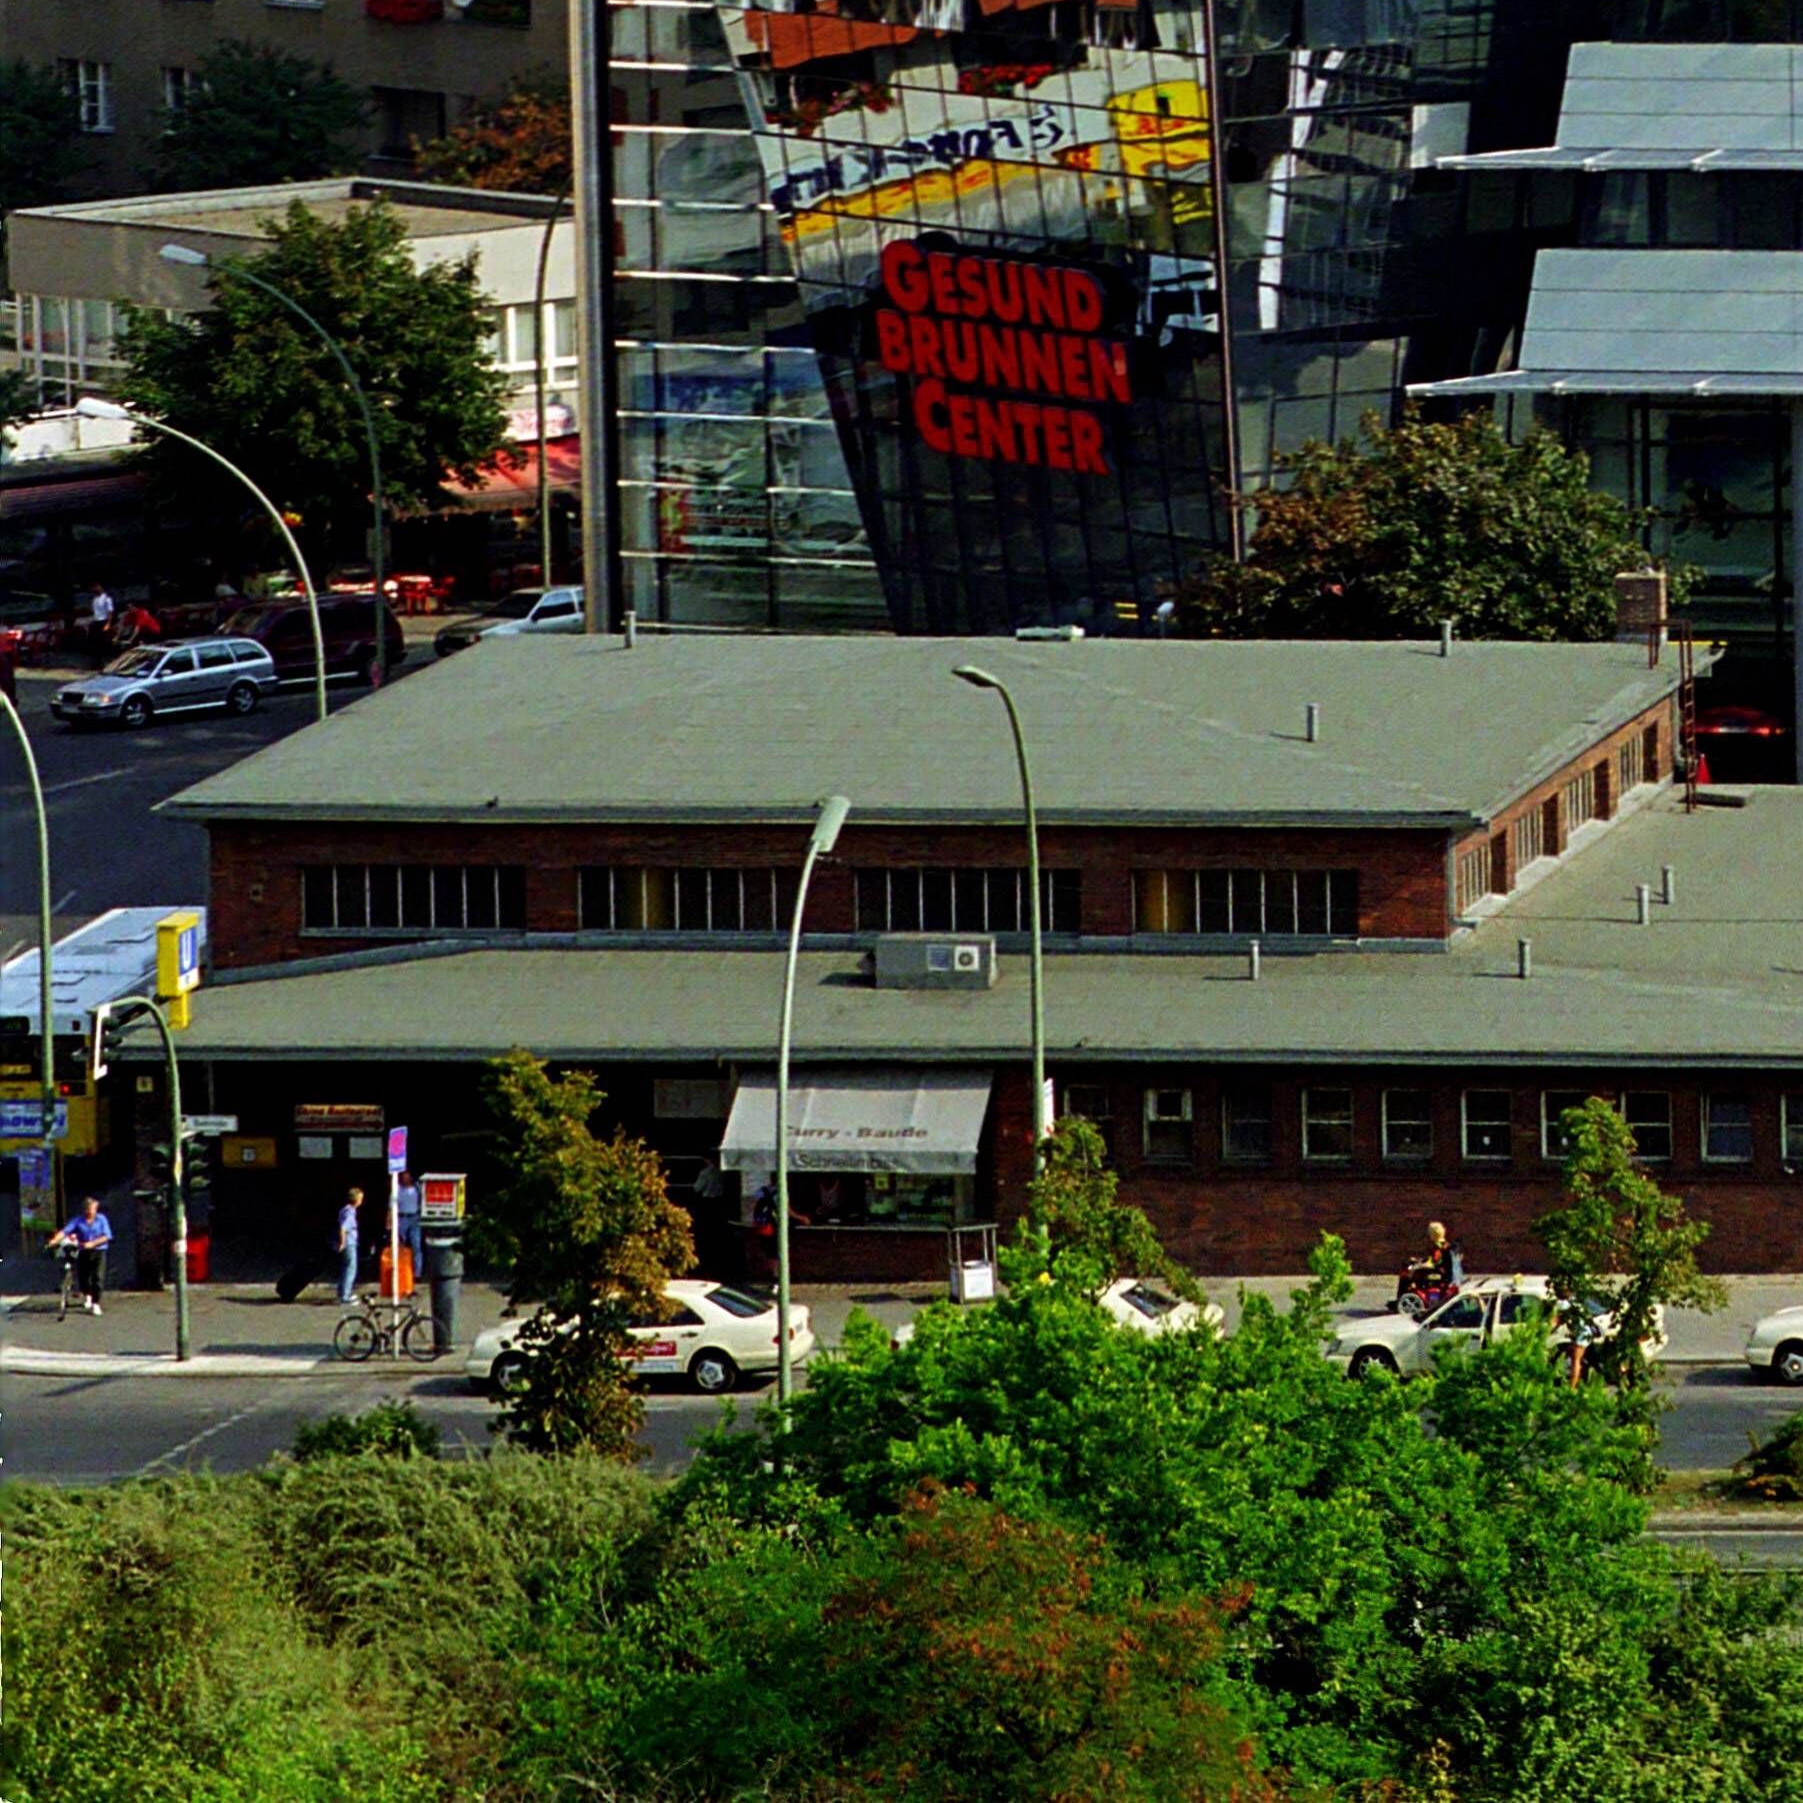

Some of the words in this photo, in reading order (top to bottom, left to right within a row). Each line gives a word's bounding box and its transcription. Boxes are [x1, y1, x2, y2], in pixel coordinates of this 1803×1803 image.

[882, 240, 1103, 331] GESUND
[879, 312, 1130, 403] BRUNNEN
[914, 380, 1108, 474] CENTER
